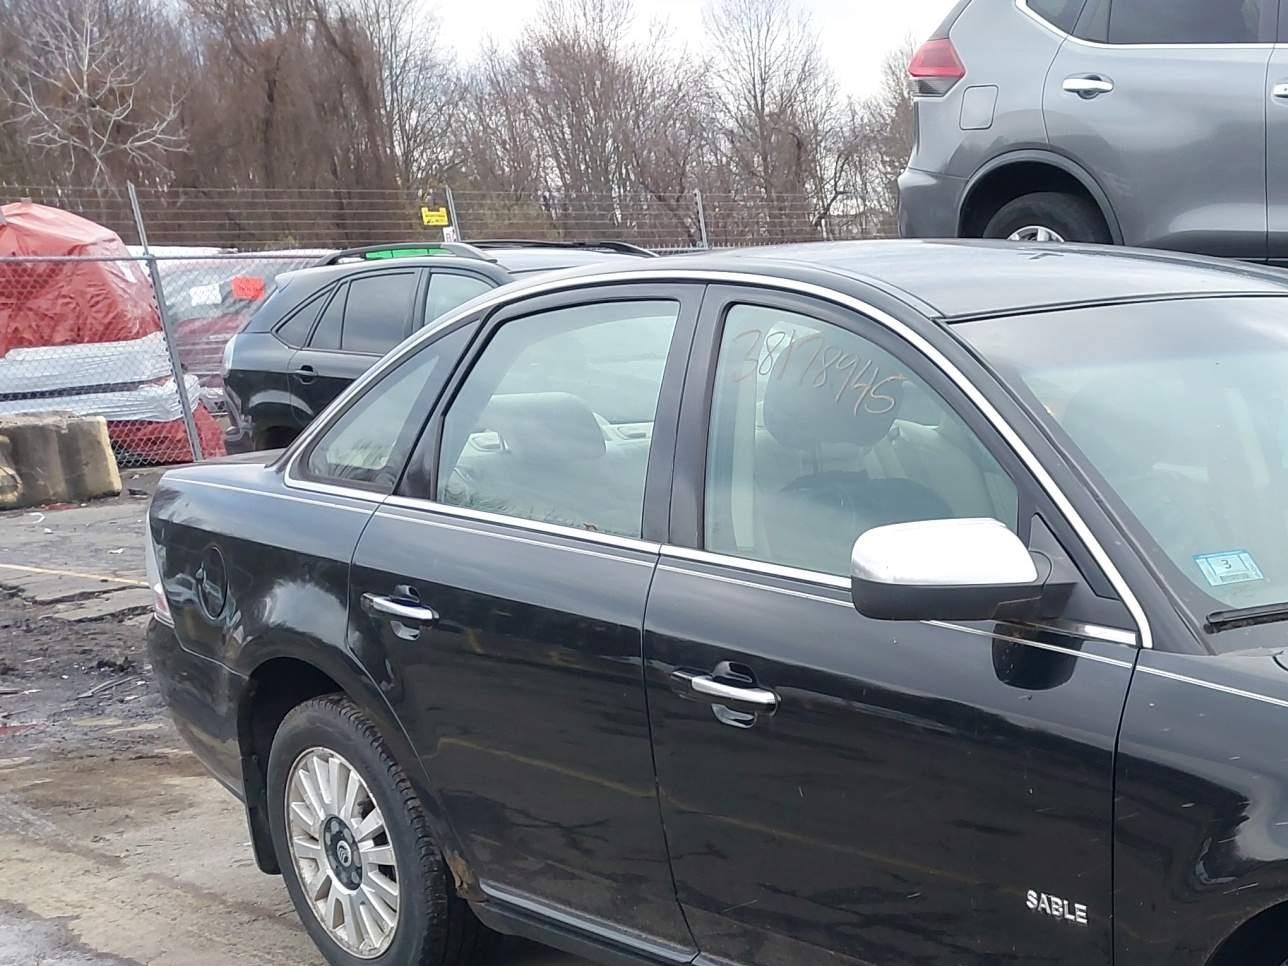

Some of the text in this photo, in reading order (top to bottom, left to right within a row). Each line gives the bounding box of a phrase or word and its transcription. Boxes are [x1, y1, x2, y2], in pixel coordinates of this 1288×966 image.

[733, 327, 902, 417] 38178945
[1220, 559, 1233, 570] 3
[1025, 889, 1089, 924] SABLE
